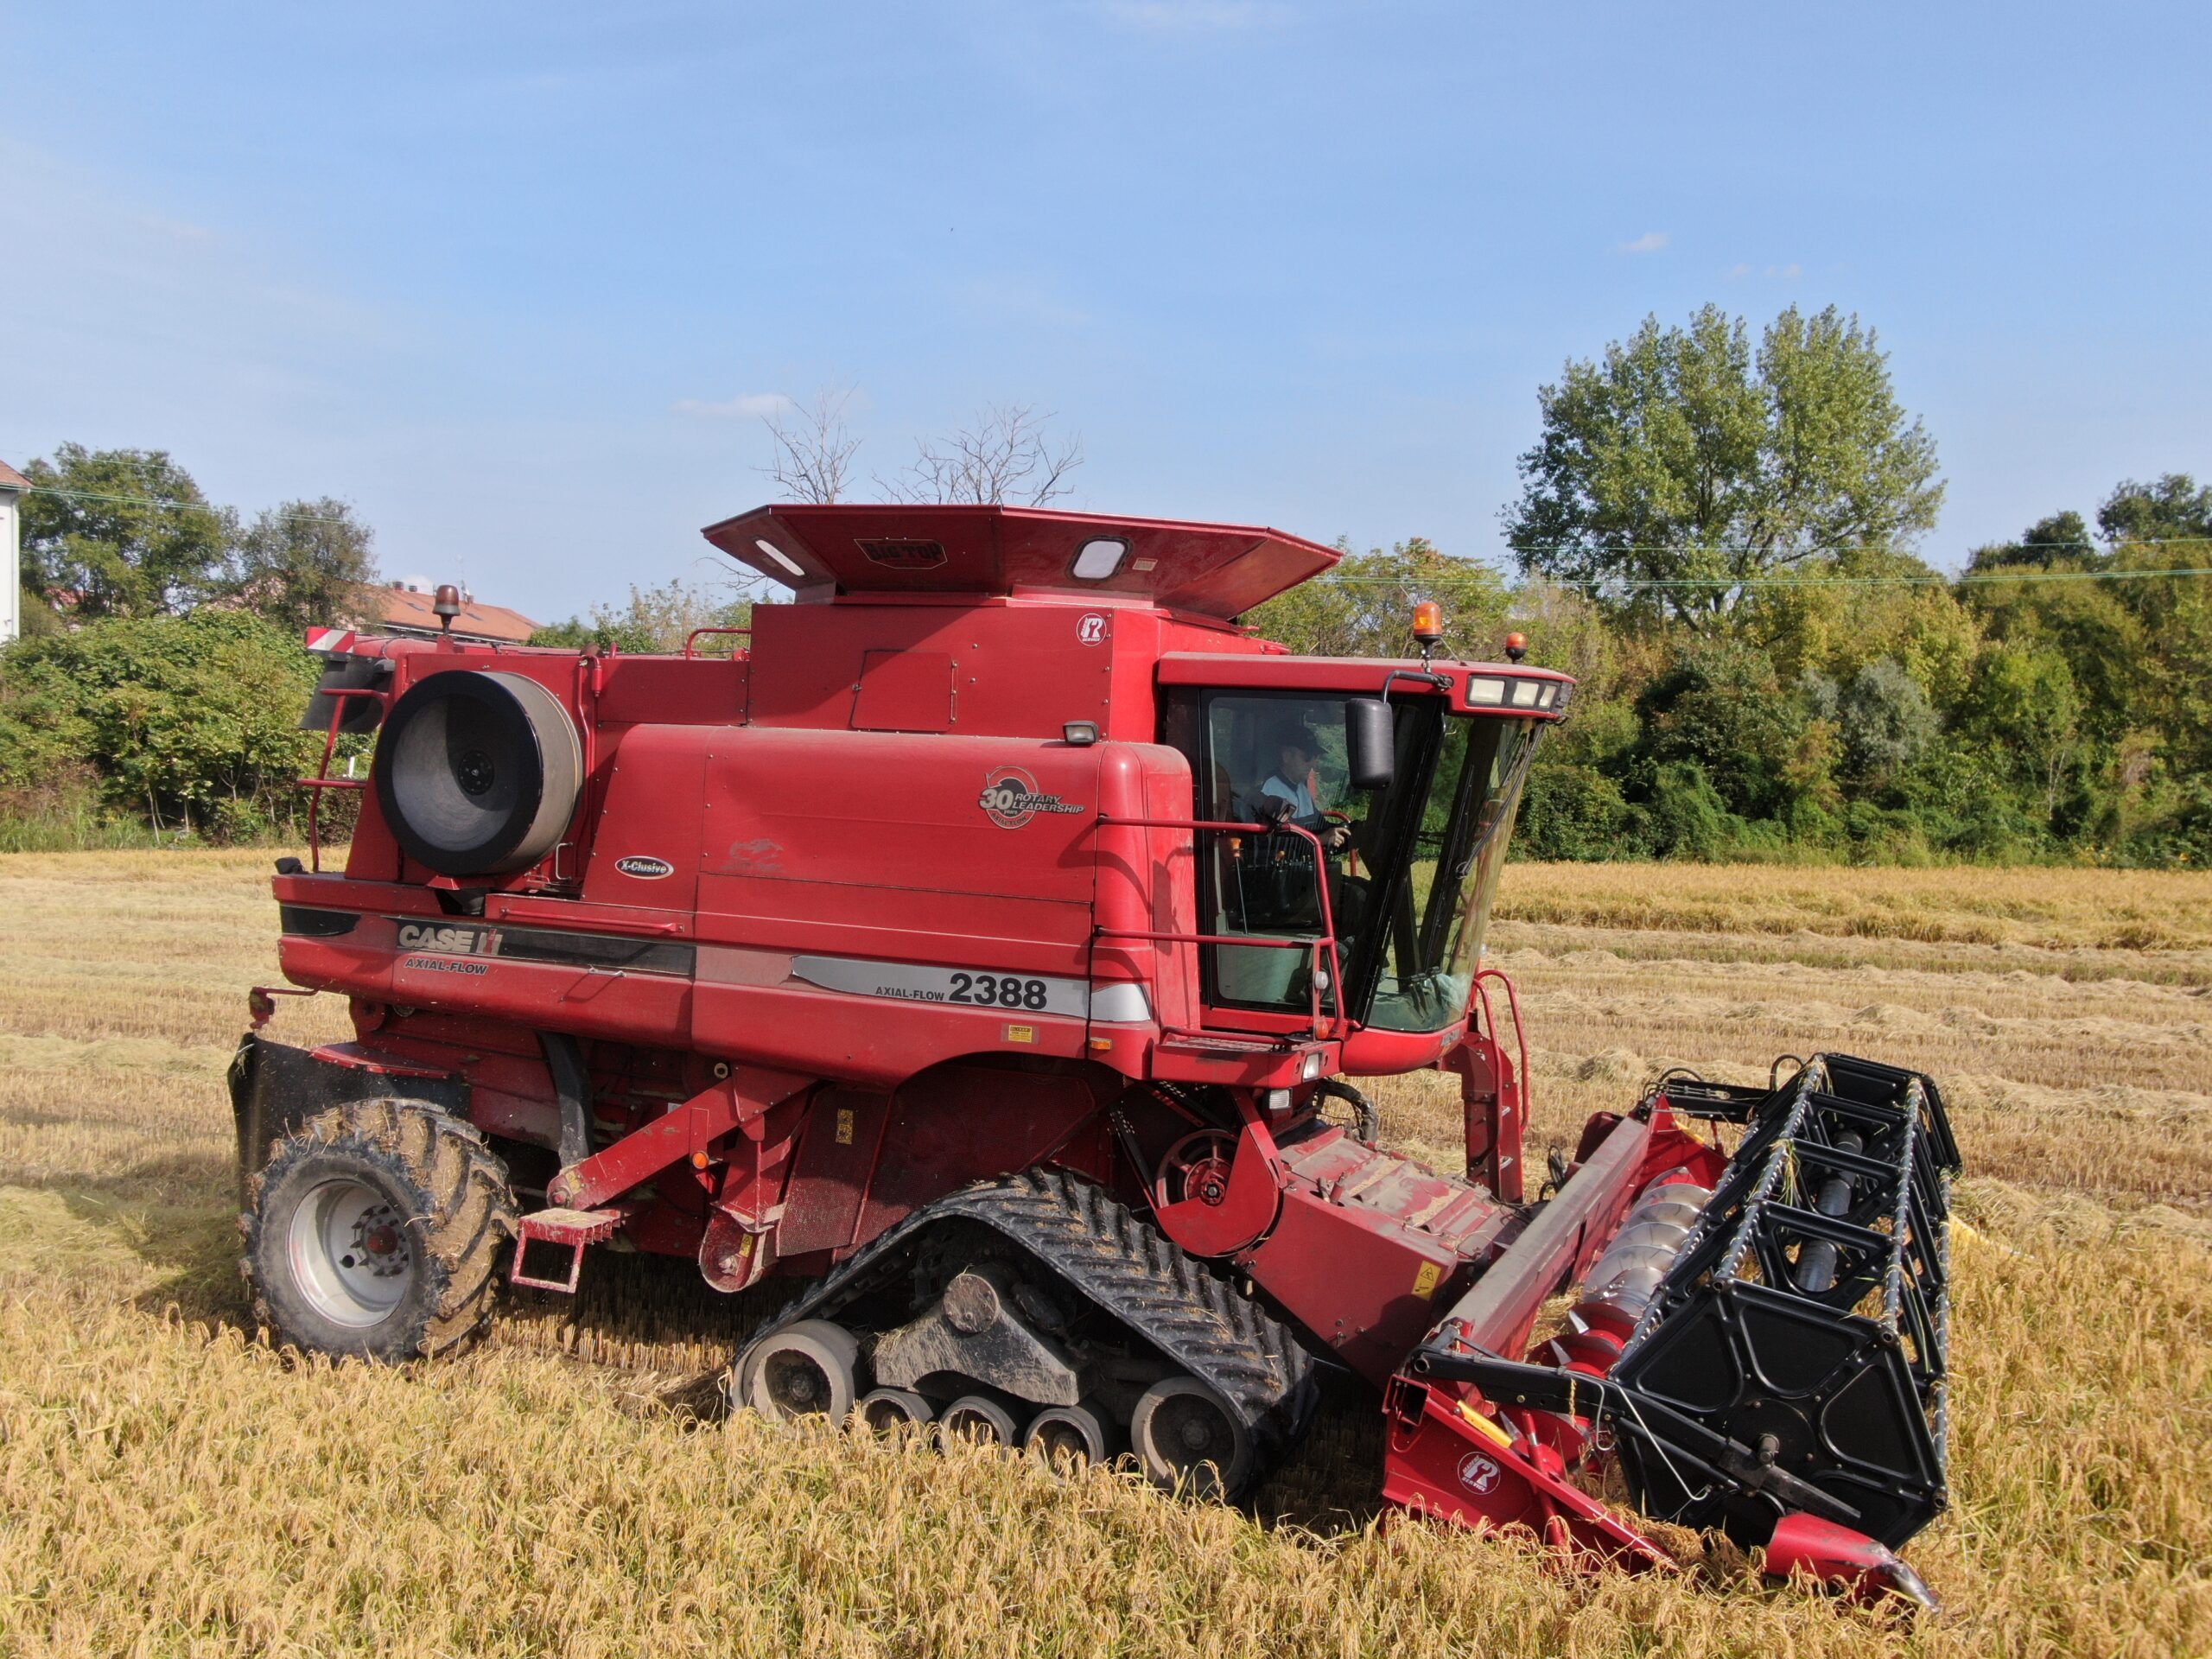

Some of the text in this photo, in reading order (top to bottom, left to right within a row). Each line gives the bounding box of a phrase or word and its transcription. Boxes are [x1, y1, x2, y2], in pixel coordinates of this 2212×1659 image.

[979, 788, 1014, 810] 30
[1012, 802, 1084, 814] LEADERSHIP
[1014, 793, 1062, 804] ROTARY
[621, 861, 667, 874] X-Clusive
[398, 925, 474, 953] CASE
[404, 957, 489, 976] AXIAL-FLOW
[875, 972, 1047, 1010] AXIAL-FLOW 2388
